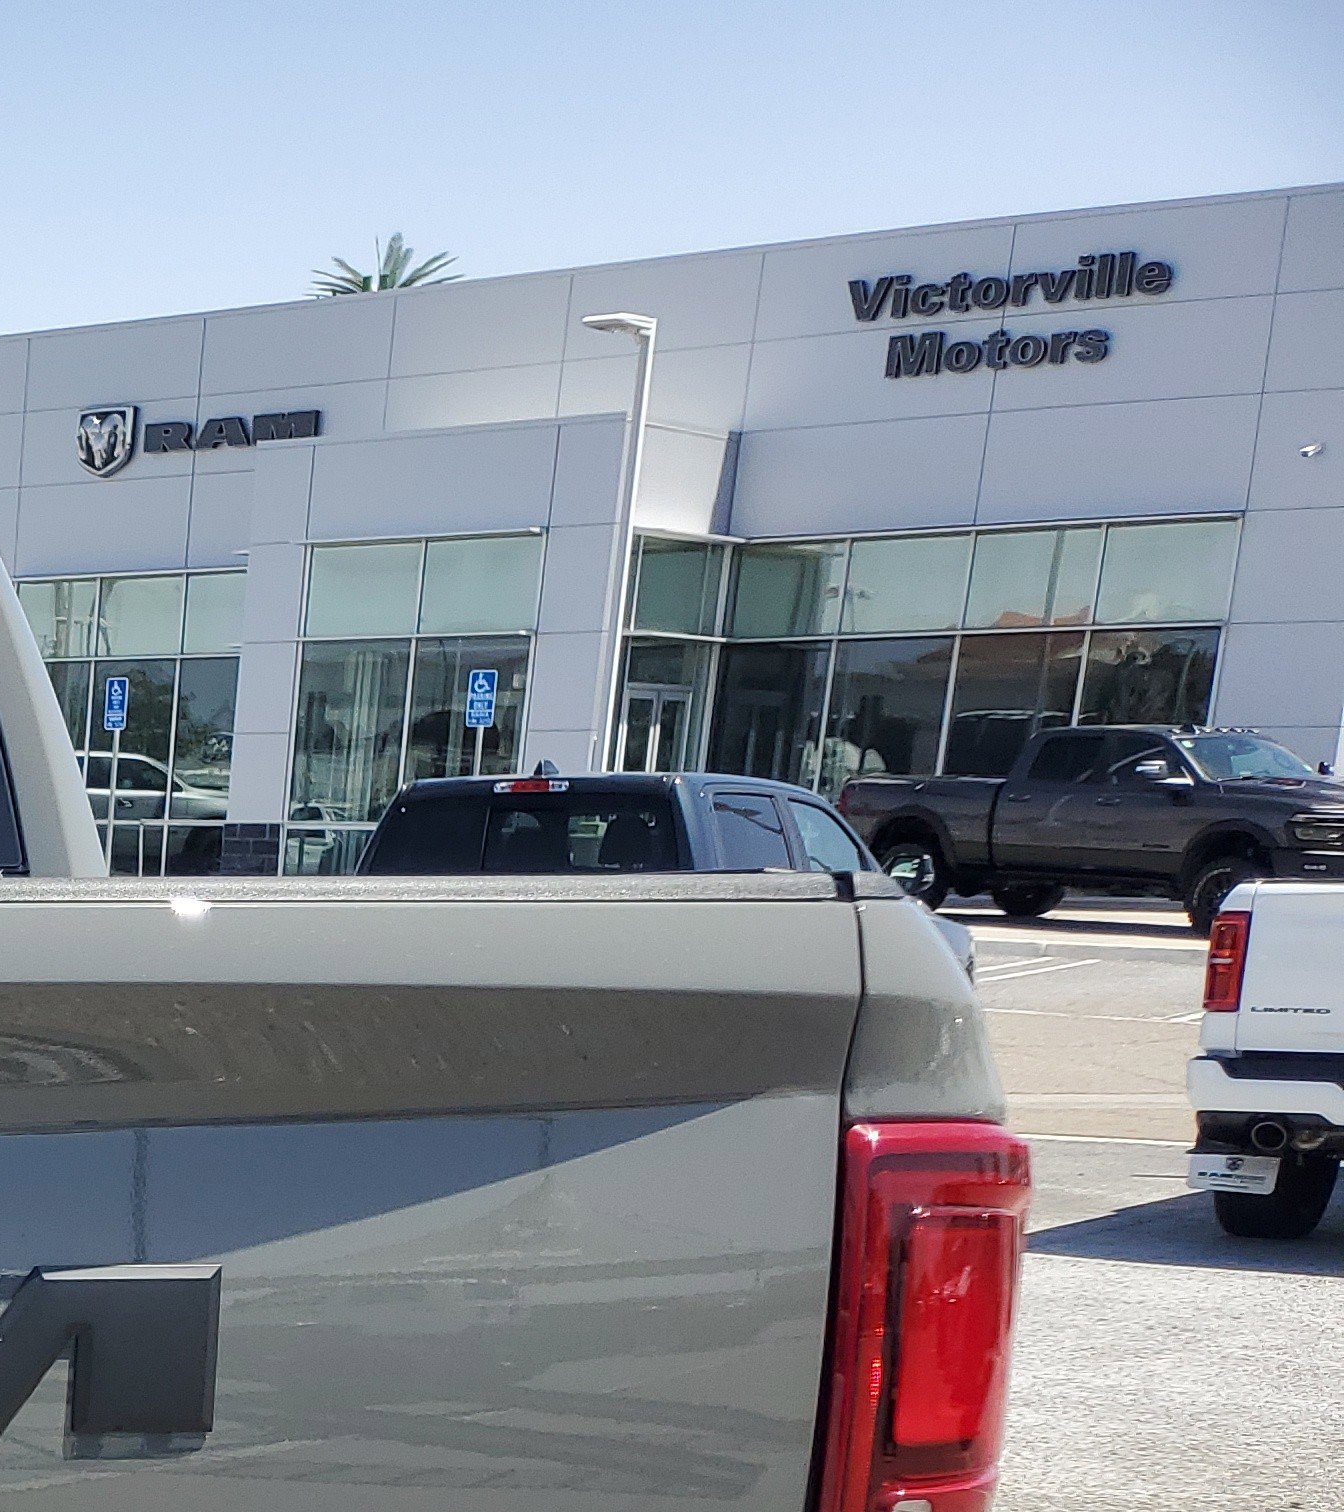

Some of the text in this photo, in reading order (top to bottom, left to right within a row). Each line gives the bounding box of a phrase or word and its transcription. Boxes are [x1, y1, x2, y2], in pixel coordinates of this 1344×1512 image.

[848, 251, 1174, 323] Victorville
[885, 327, 1111, 379] Motors
[143, 410, 321, 453] RAM
